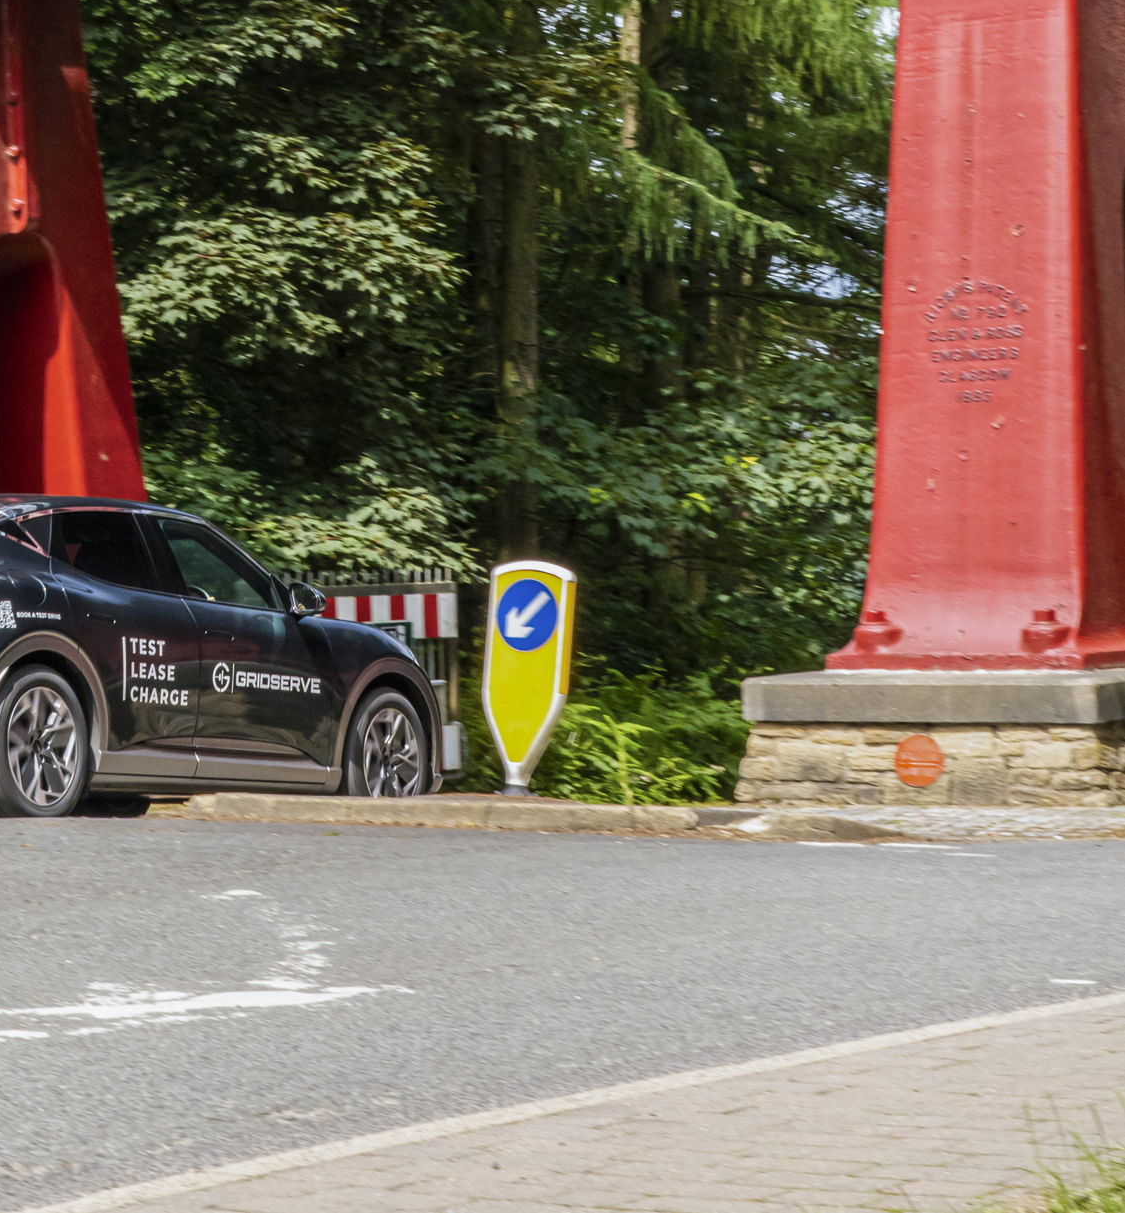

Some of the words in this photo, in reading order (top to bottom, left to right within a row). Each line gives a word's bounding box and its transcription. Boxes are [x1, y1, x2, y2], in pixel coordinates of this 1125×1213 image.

[931, 346, 1020, 363] ENGINEERS
[938, 368, 1012, 383] GLASGOW
[130, 638, 165, 657] TEST
[131, 662, 175, 682] LEASE
[235, 671, 321, 694] GRIDSERVE
[130, 686, 189, 706] CHARGE
